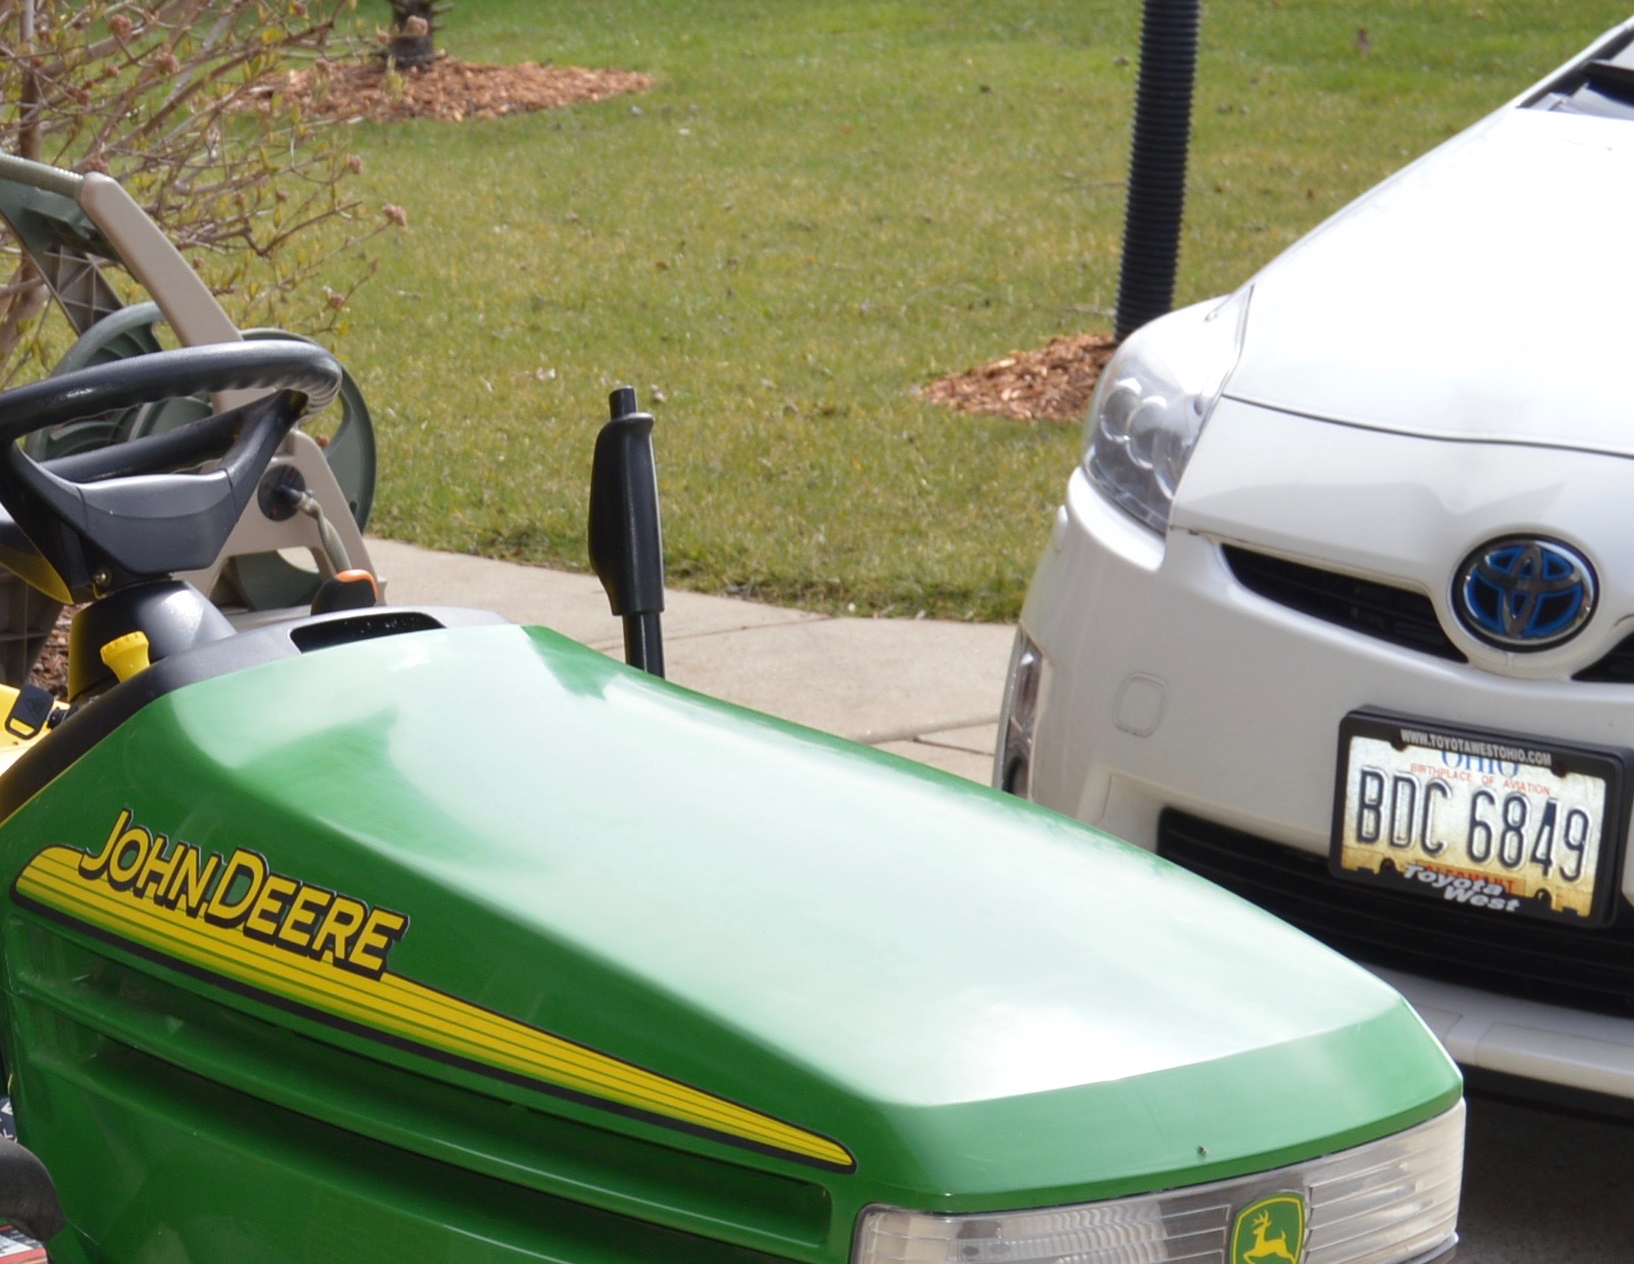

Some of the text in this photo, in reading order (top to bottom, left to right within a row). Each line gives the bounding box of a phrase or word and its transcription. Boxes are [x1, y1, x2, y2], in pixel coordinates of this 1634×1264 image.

[1400, 729, 1552, 767] WWW.TOYOTAWESTOHIO.COM
[1410, 762, 1551, 796] BIRTHPLACE OF AVIATION
[1355, 766, 1591, 883] BDC 6849
[78, 808, 410, 982] JOHN DEERE
[1403, 864, 1503, 896] Toyota
[1443, 884, 1521, 912] West
